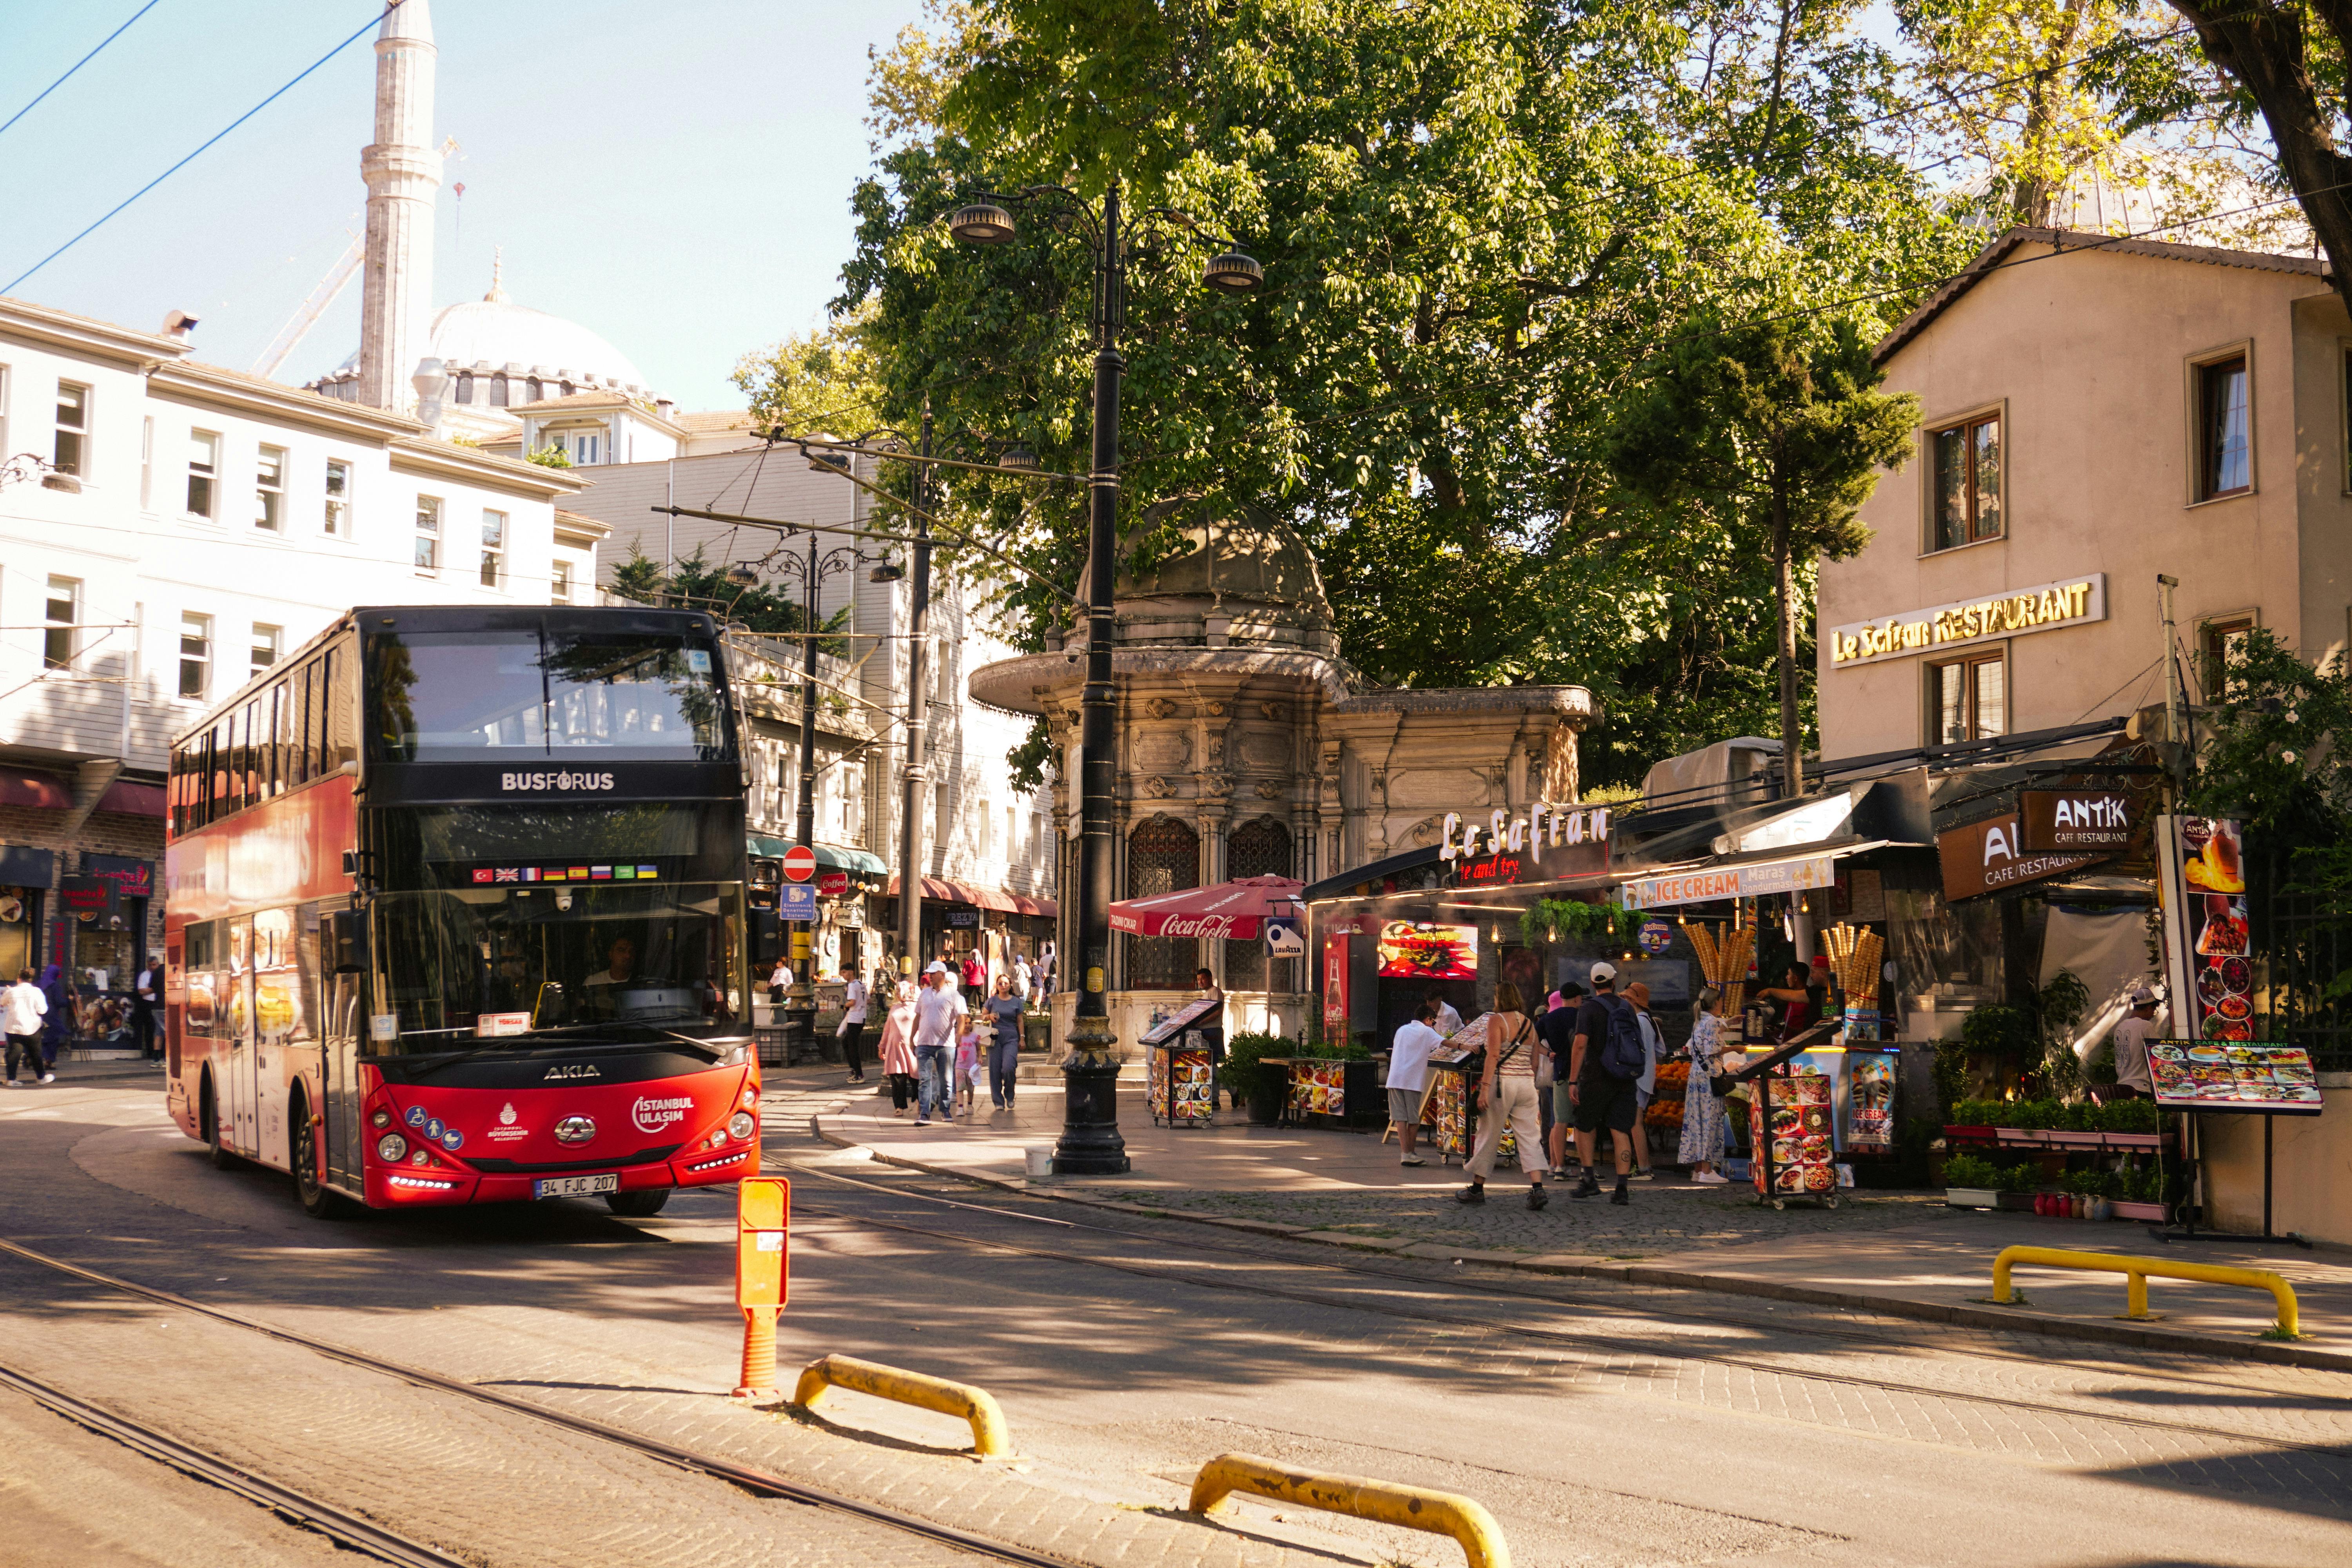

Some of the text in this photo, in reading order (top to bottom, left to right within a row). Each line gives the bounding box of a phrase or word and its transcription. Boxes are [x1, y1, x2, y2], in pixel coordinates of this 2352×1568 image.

[1833, 582, 2091, 662] Le Safran RESTAURANT
[502, 771, 615, 790] BUSFORUS
[1439, 802, 1609, 865] Le Safran
[2055, 833, 2127, 843] CAFE RESTAURANT
[1473, 854, 1501, 878] and
[1748, 866, 1786, 882] Maraş
[823, 879, 845, 889] Coffee
[1656, 871, 1740, 902] ICE CREAM
[1742, 880, 1793, 894] Dondurması
[1111, 915, 1136, 930] TADINI ÇIKAR
[1275, 945, 1301, 953] LAVAZZA
[543, 1065, 601, 1081] AKIA
[639, 1096, 695, 1112] İSTANBUL
[639, 1110, 684, 1127] ULAŞIM
[1853, 1109, 1888, 1121] ICE CREAM
[543, 1181, 557, 1194] 34
[564, 1179, 586, 1193] FJC
[594, 1176, 615, 1190] 207
